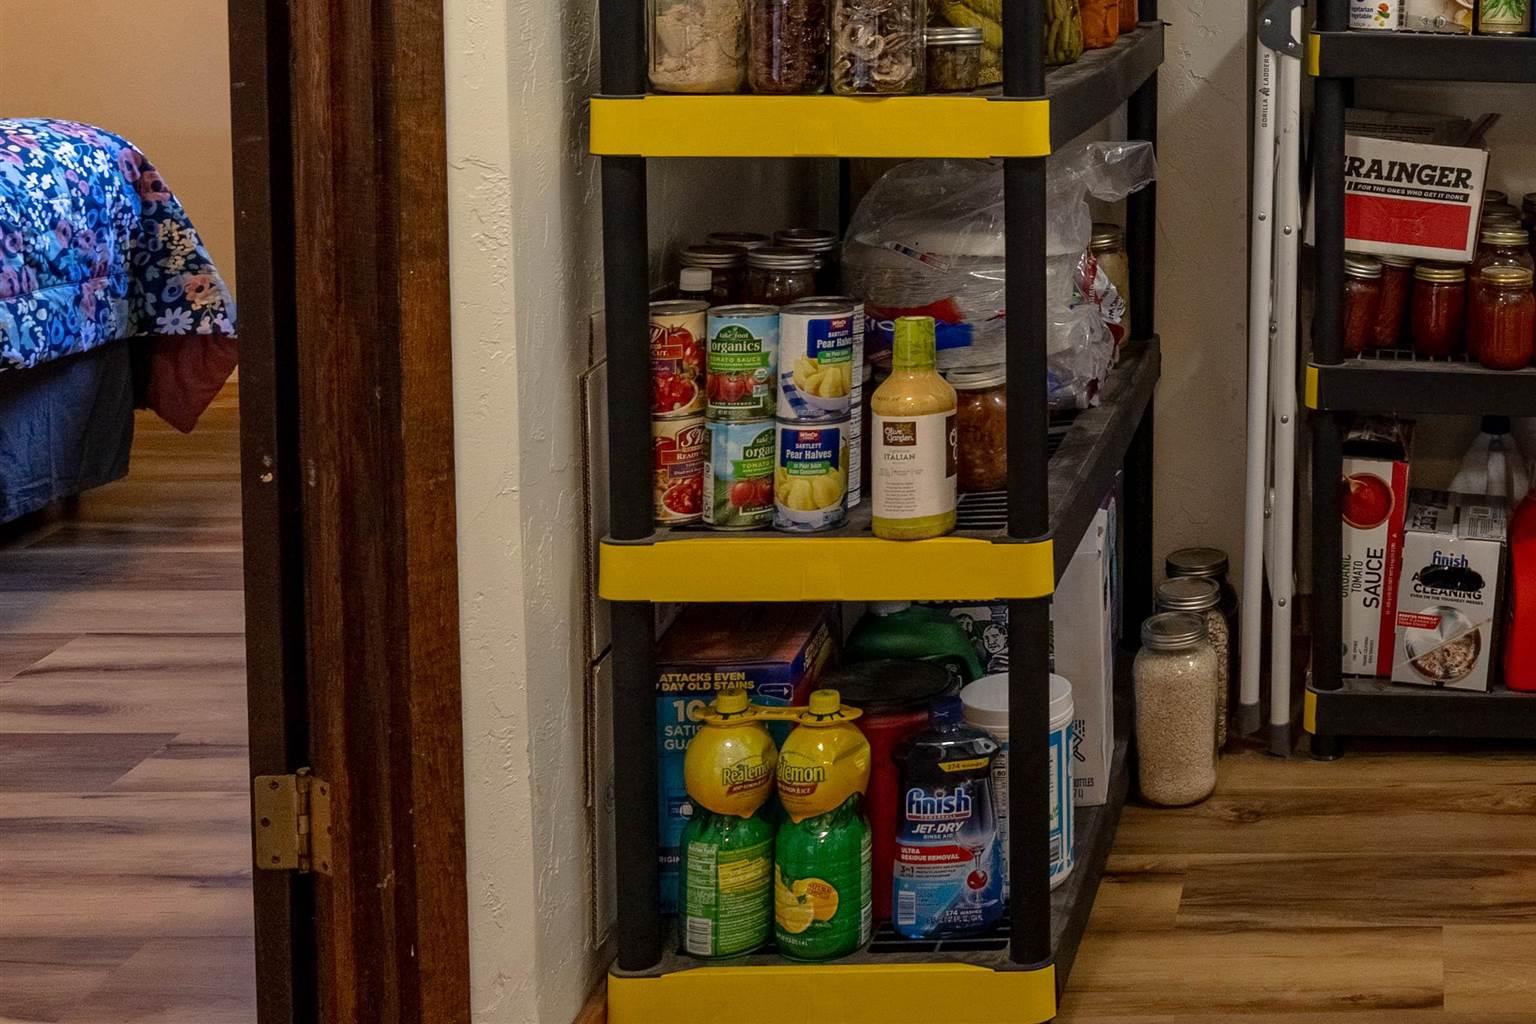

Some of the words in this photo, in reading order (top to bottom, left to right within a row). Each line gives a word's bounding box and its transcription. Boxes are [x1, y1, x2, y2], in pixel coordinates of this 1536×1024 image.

[1373, 185, 1385, 193] THE
[1446, 193, 1465, 201] DONE
[711, 341, 761, 354] organics
[817, 338, 835, 349] Pear
[785, 450, 802, 459] Pear
[805, 450, 832, 459] Halves
[884, 453, 915, 461] ITALIAN
[1433, 549, 1469, 568] finish
[1351, 560, 1363, 593] TOMATO
[1363, 547, 1384, 609] SAUCE
[659, 672, 712, 683] ATTACKS
[714, 672, 746, 681] EVEN
[663, 681, 686, 692] DAY
[687, 681, 711, 691] OLD
[713, 680, 755, 690] STAINS
[906, 787, 971, 814] finish
[912, 821, 965, 834] JET-DRY
